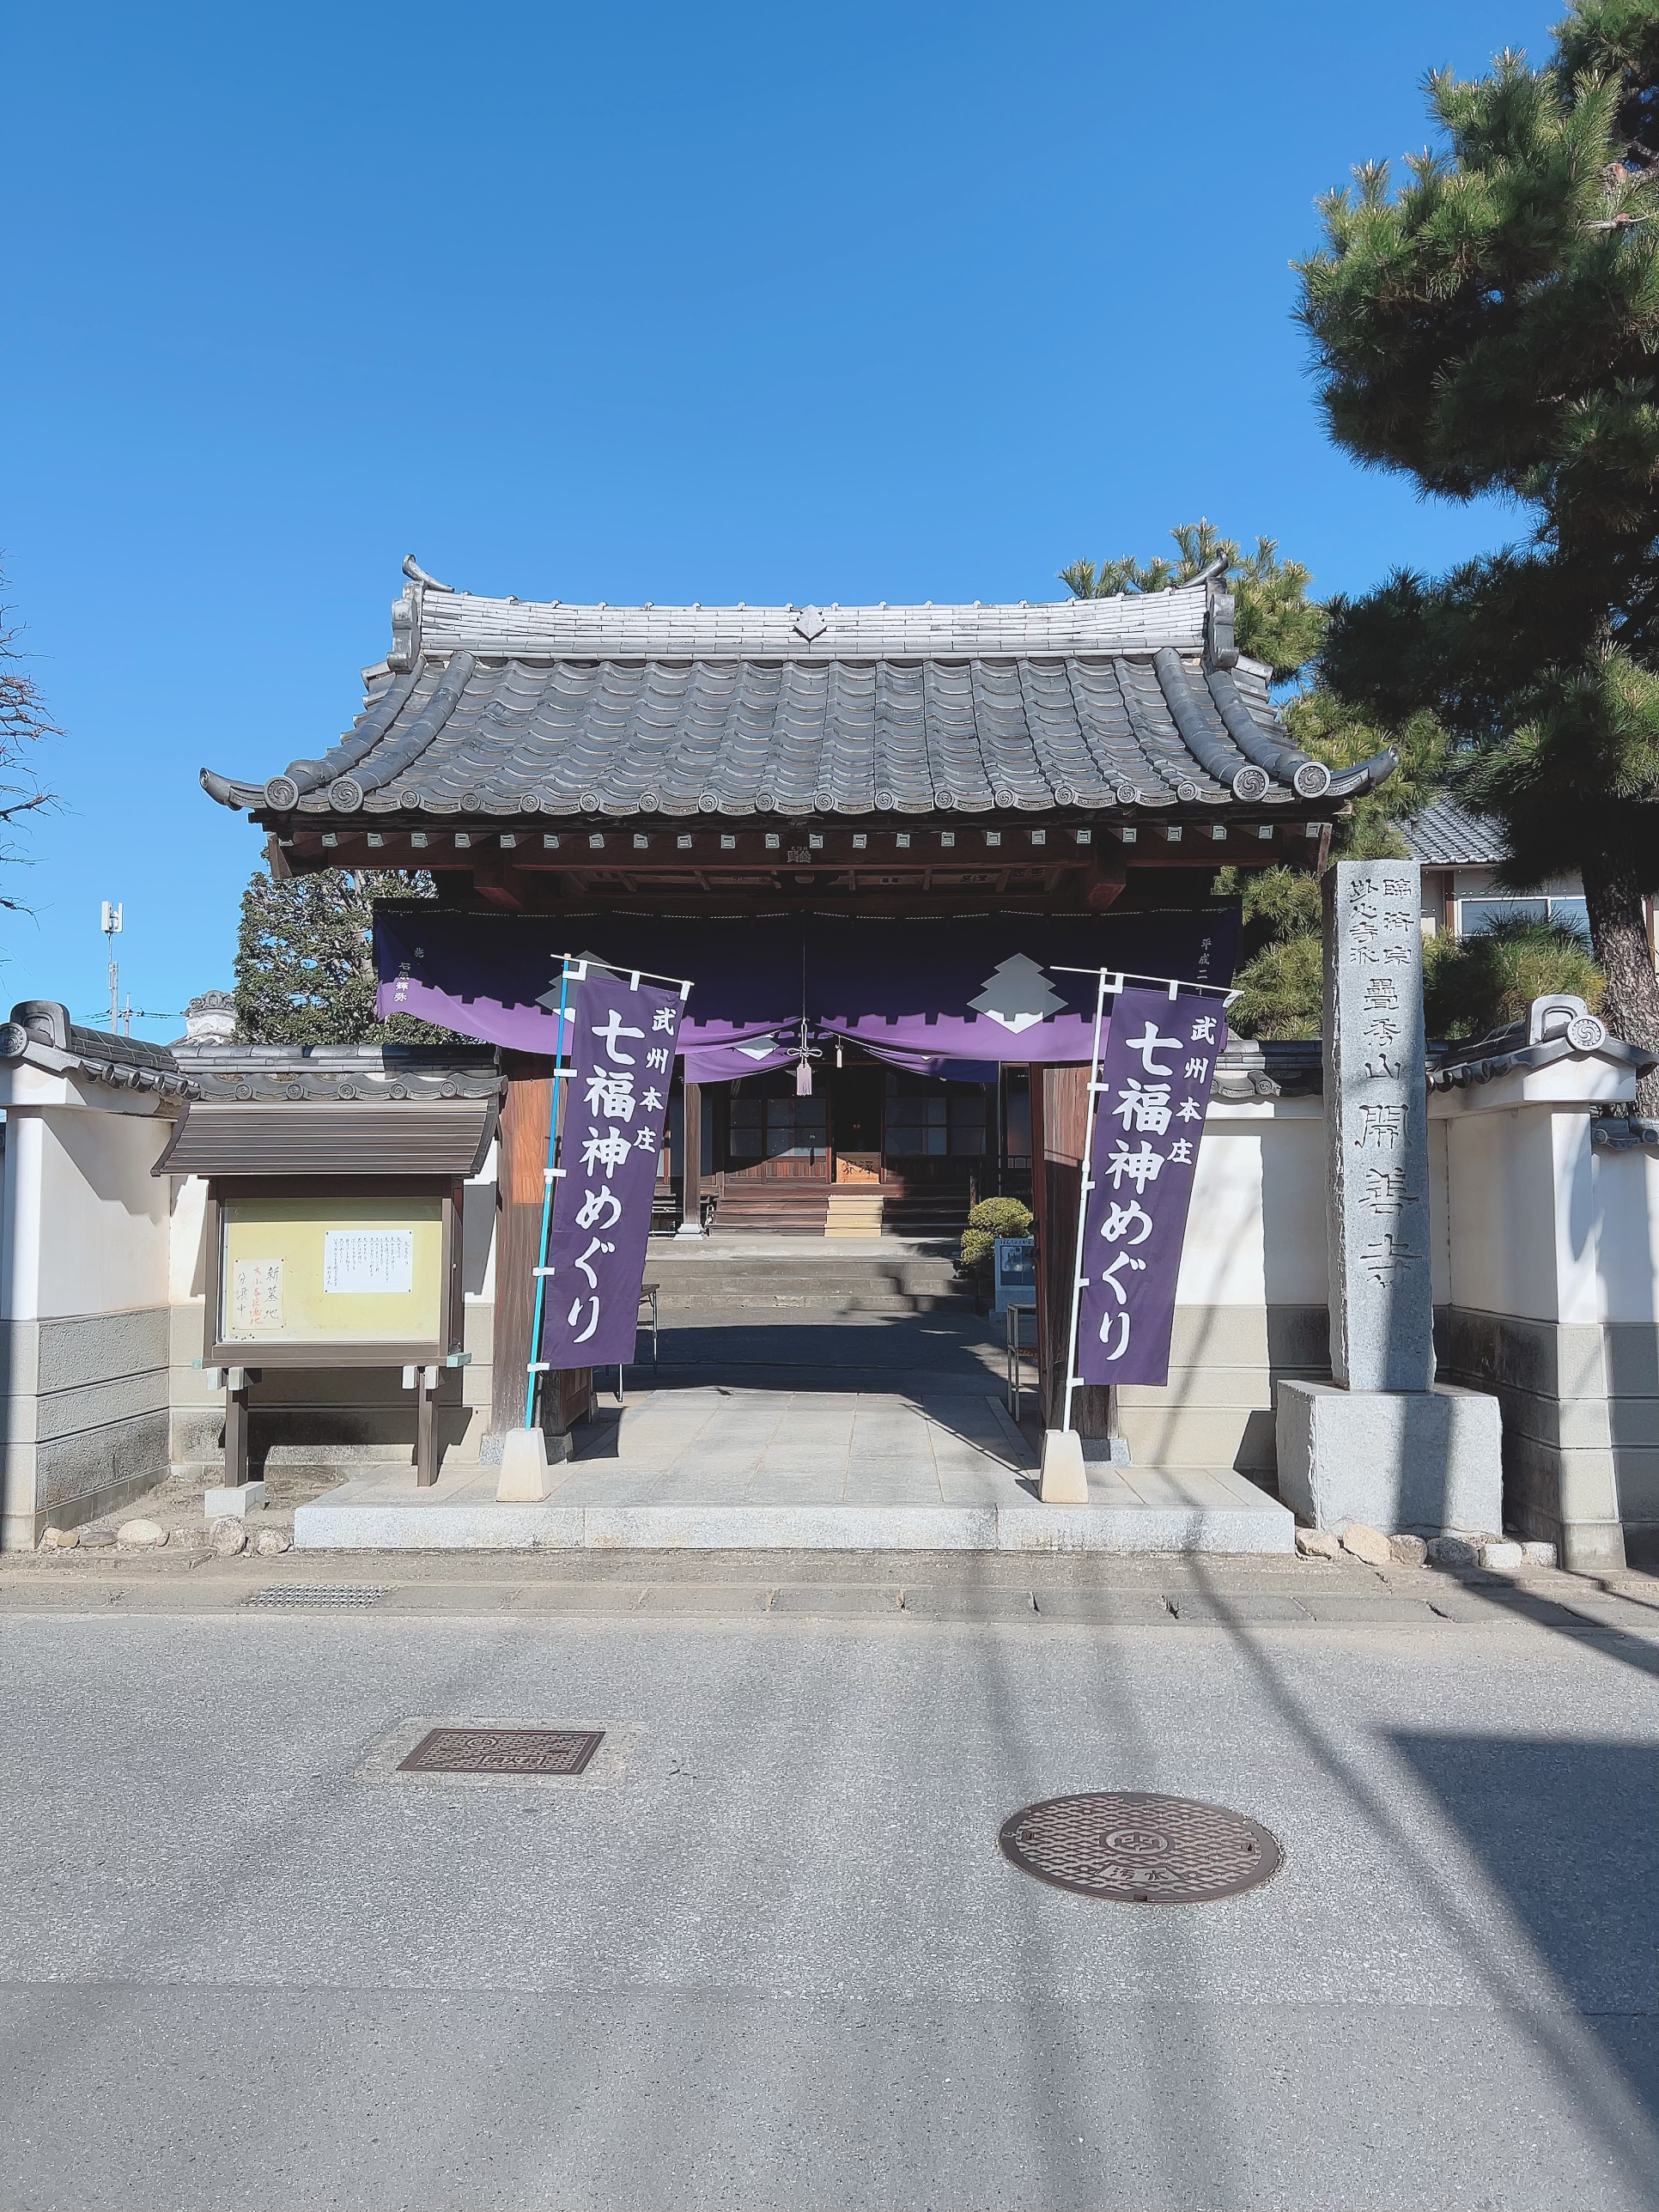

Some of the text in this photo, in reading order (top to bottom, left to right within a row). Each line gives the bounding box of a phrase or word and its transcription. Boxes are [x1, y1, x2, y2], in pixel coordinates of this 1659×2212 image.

[634, 1006, 677, 1153] 武州本庄
[1166, 1015, 1218, 1165] 武州本庄
[567, 1008, 646, 1345] 七福神めぐり
[1098, 1020, 1184, 1362] 七福神めぐり
[234, 1272, 250, 1318] 分譲中
[263, 1266, 280, 1320] 新墓地
[1109, 1867, 1170, 1881] 汚水
